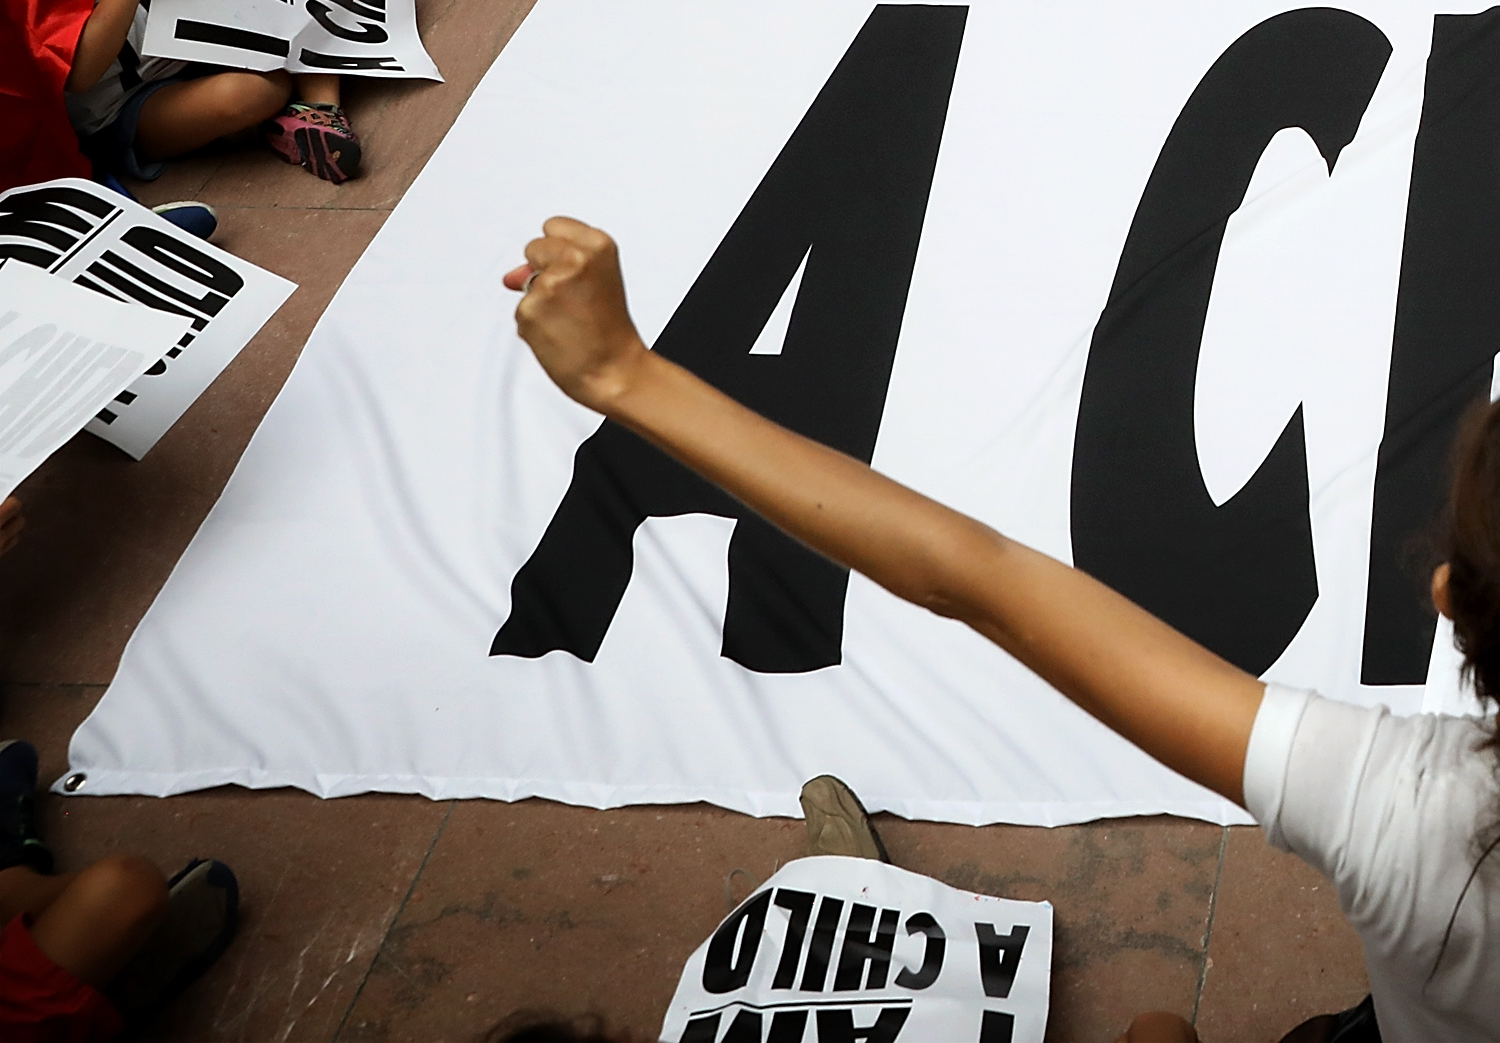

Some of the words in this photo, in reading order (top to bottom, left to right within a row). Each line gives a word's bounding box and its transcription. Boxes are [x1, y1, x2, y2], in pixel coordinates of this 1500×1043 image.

[174, 19, 290, 58] I
[299, 48, 405, 72] A
[489, 3, 968, 673] A
[703, 887, 946, 994] CHILD
[974, 922, 1031, 999] A
